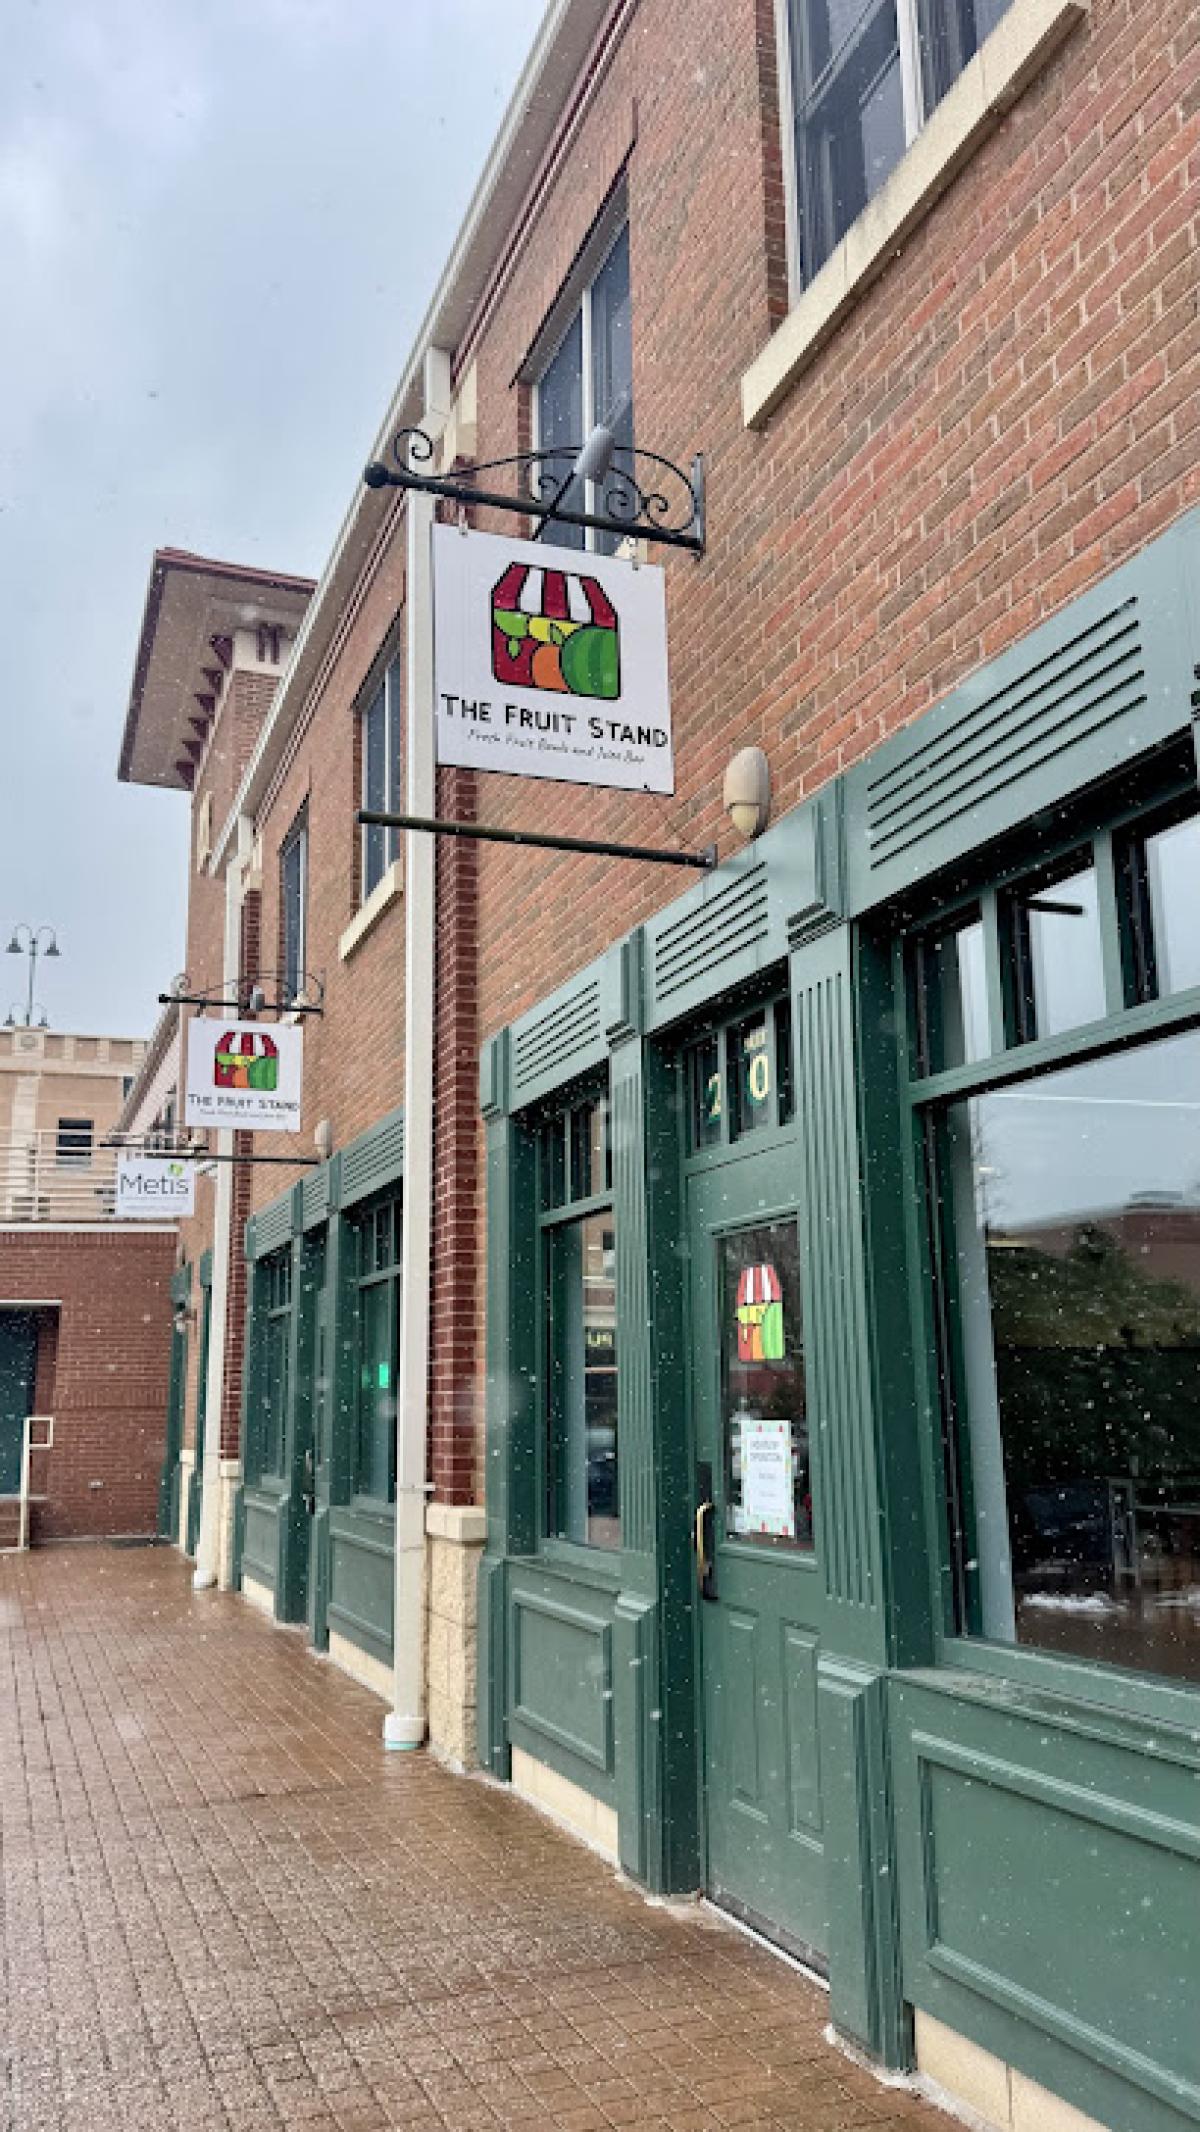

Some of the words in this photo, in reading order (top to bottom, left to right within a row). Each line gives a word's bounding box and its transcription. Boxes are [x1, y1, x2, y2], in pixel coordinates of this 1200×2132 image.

[440, 693, 492, 724] THE
[504, 703, 577, 736] FRUIT
[588, 716, 669, 748] STAND
[467, 728, 501, 744] Fresh
[505, 732, 534, 749] Fruit
[537, 736, 568, 753] Bowls
[571, 745, 595, 757] and
[187, 1093, 213, 1106] THE
[217, 1096, 253, 1109] FRUIT
[258, 1099, 299, 1112] STAND
[120, 1173, 189, 1195] Metis
